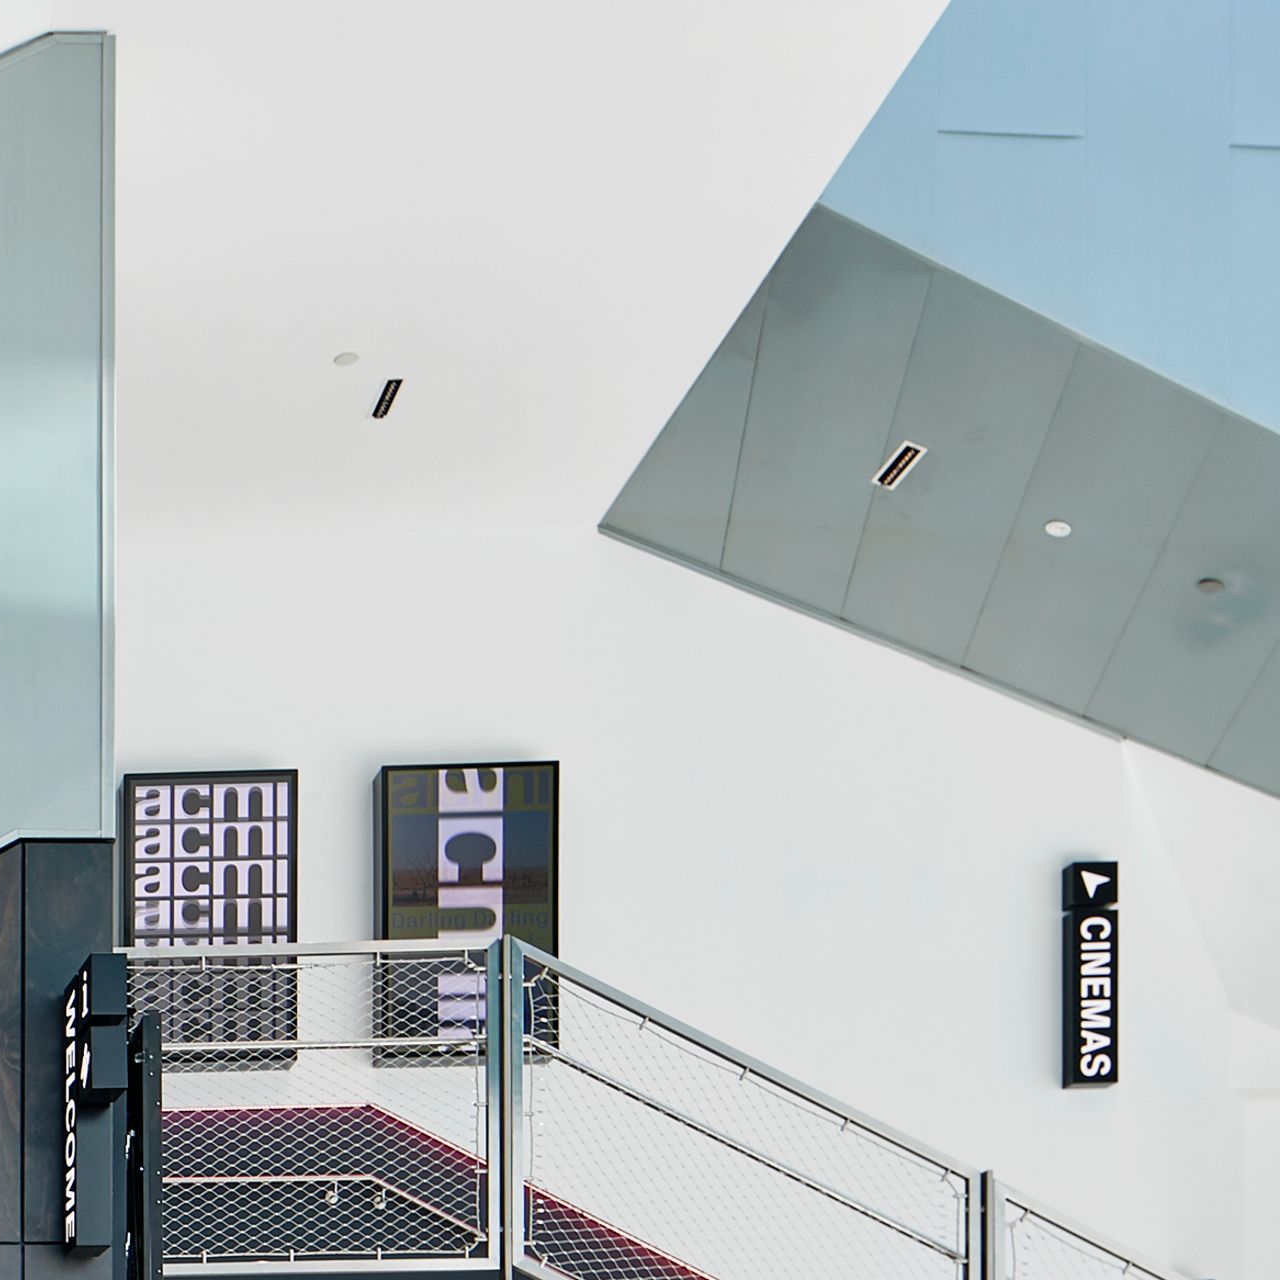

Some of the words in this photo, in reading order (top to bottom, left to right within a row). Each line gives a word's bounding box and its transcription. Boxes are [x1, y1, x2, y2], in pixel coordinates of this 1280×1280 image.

[135, 782, 288, 820] acmi
[135, 821, 288, 859] acmi
[135, 859, 288, 897] acmi
[135, 897, 288, 937] acmi
[393, 910, 466, 929] Darling
[1080, 916, 1111, 1077] CINEMAS
[65, 989, 76, 1243] WELCOME
